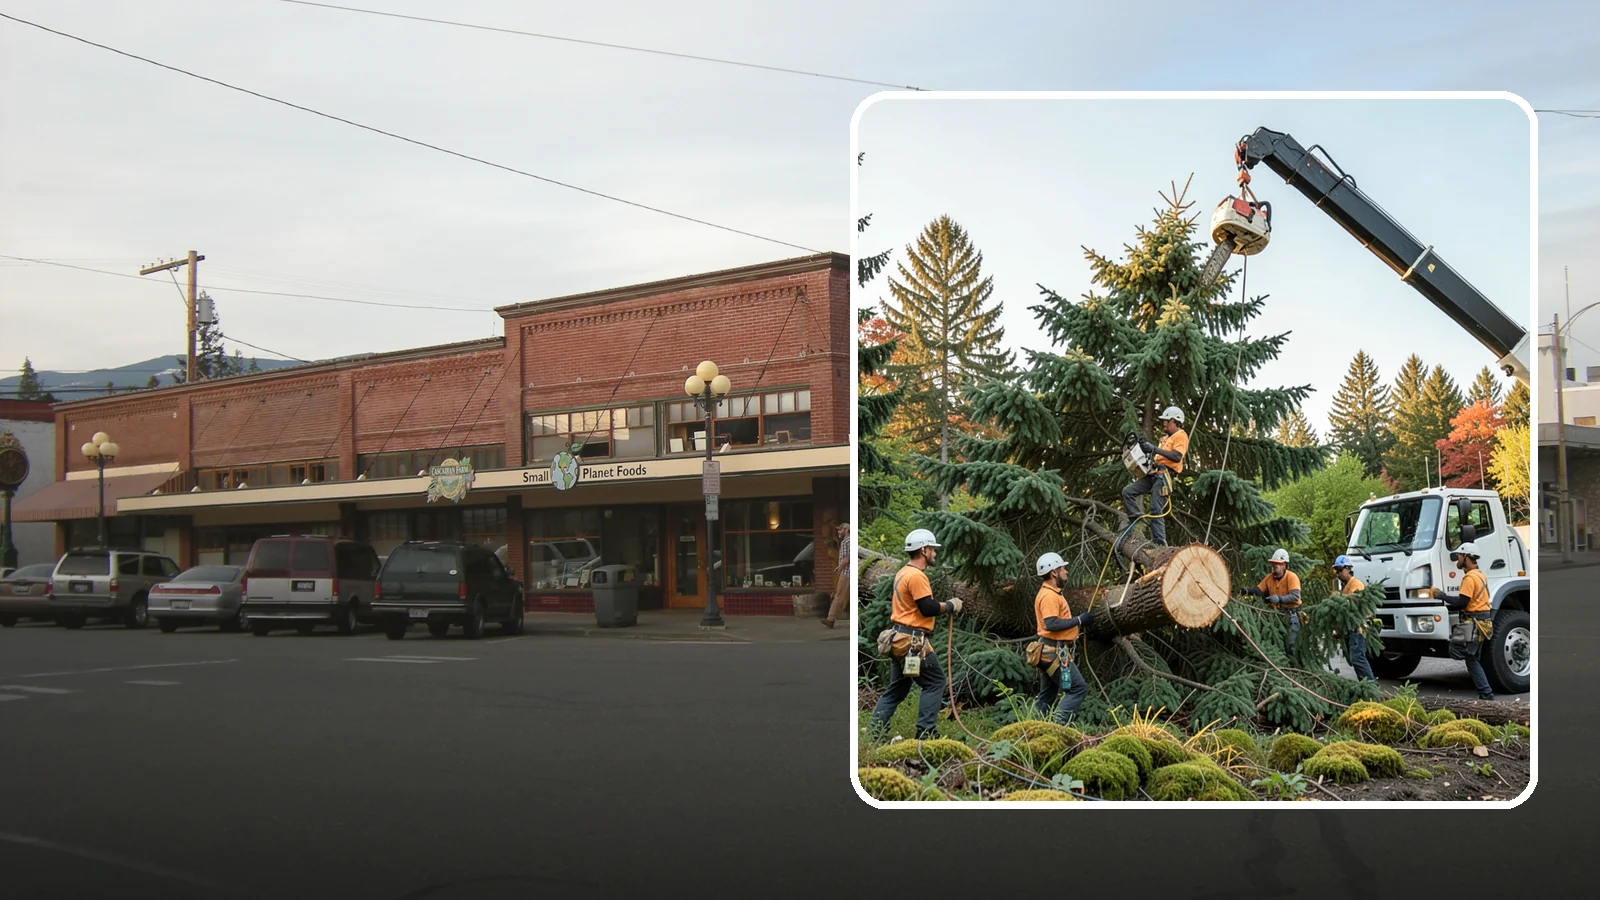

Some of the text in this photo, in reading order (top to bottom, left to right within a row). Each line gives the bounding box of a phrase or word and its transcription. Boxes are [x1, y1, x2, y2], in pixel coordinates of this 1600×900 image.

[523, 464, 647, 483] Small Planet Foods
